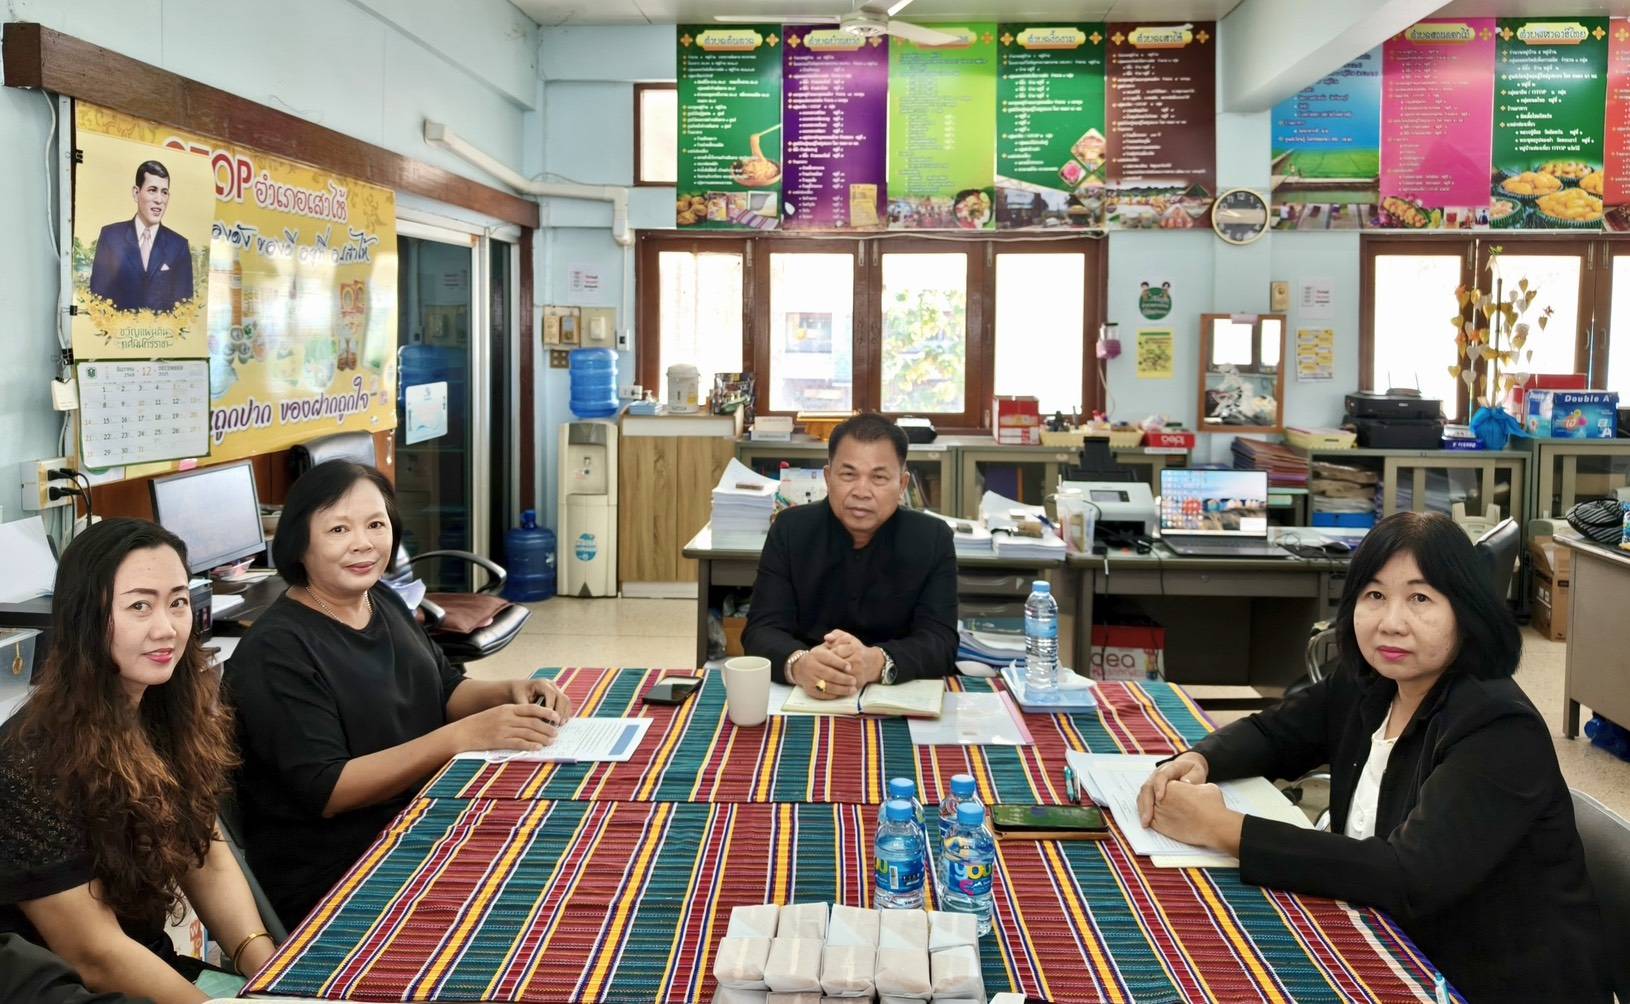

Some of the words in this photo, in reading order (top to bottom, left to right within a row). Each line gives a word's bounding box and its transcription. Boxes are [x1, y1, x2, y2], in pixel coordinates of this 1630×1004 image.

[254, 173, 348, 222] อำเภอเสาไห้
[212, 223, 256, 248] องดัง
[209, 398, 272, 441] ถูกปาก
[280, 376, 369, 422] ของฝากถูกใจ
[1564, 394, 1599, 403] Double
[1603, 394, 1610, 403] A
